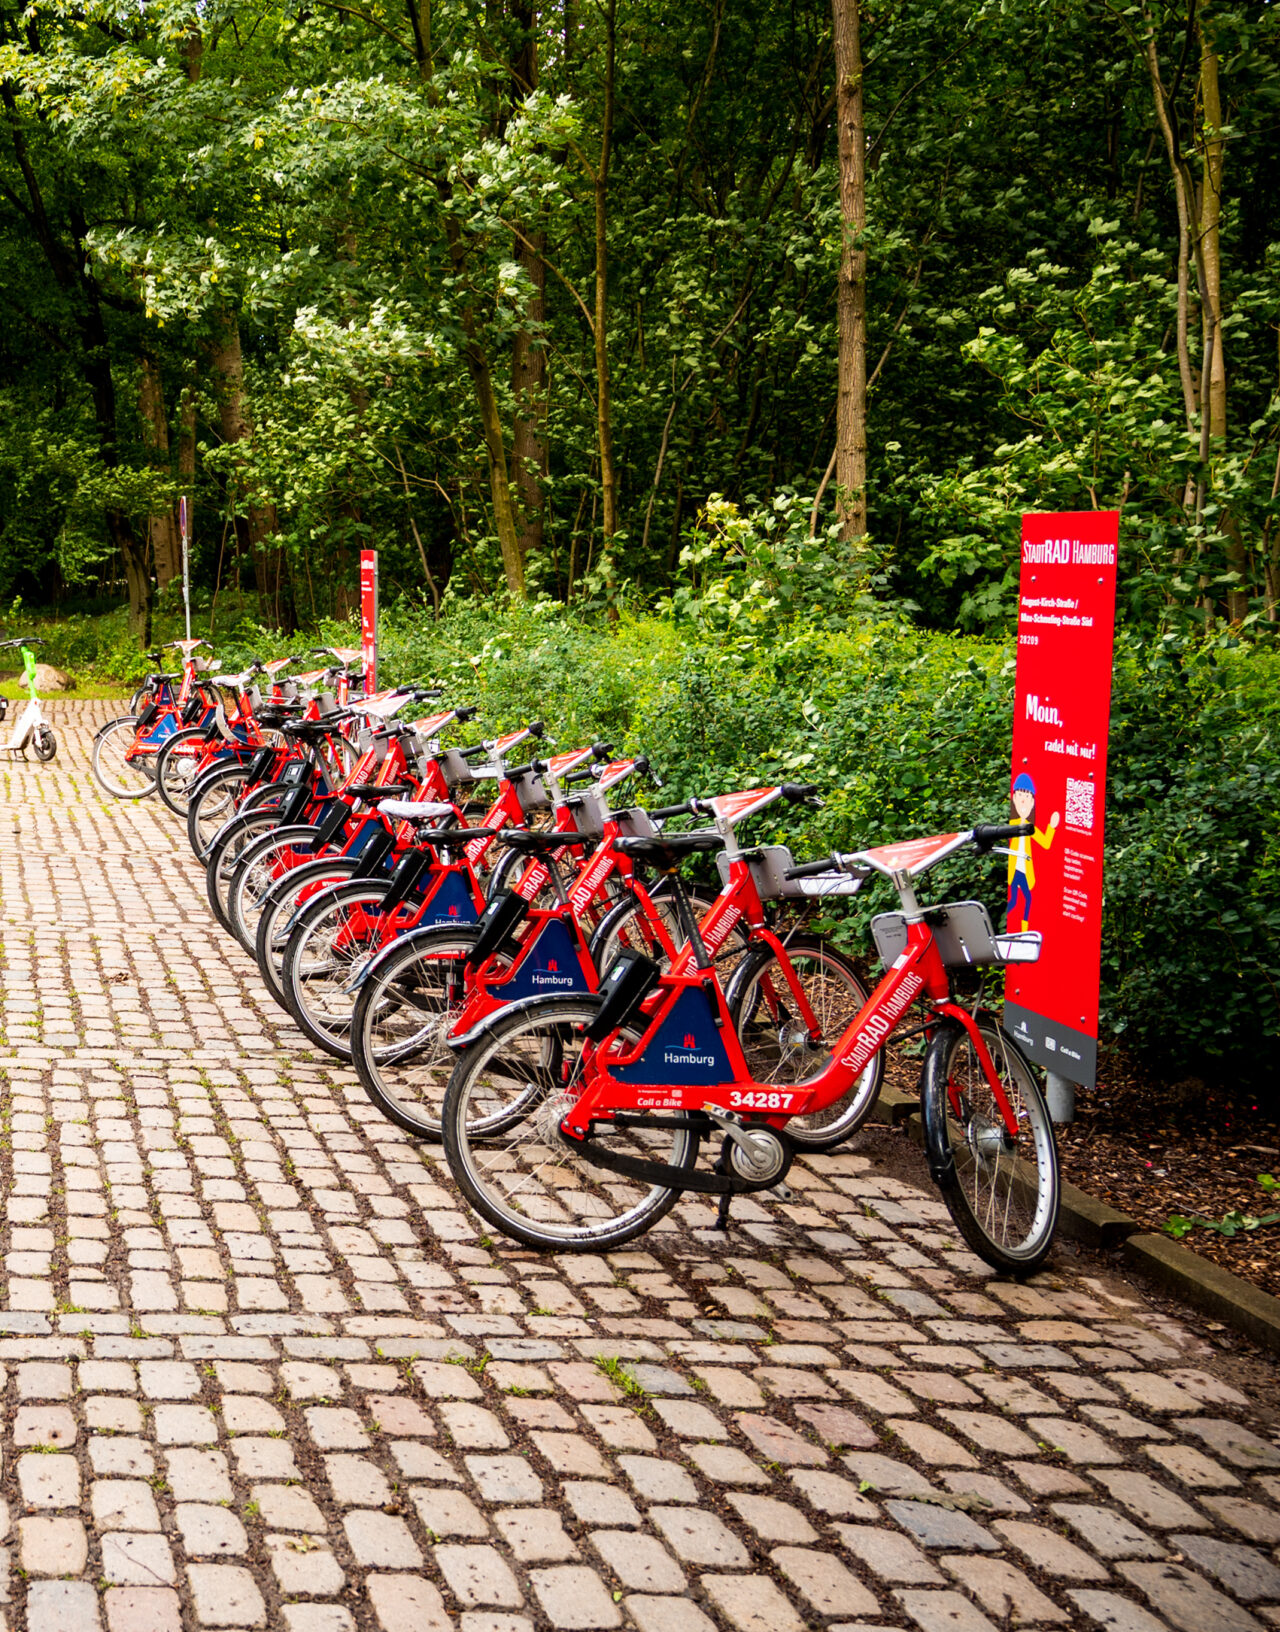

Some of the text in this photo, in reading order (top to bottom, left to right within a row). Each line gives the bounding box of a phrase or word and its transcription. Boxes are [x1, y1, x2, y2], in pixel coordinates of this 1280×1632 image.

[1026, 693, 1063, 728] Moin,
[1045, 739, 1064, 754] radel
[487, 808, 508, 831] MBURG
[705, 904, 742, 945] HAMBURG
[532, 976, 573, 987] Hamburg
[878, 971, 923, 1020] HAMBURG
[664, 1052, 715, 1067] Hamburg
[637, 1097, 654, 1107] Call
[663, 1098, 682, 1107] Bike
[729, 1090, 794, 1109] 34287
